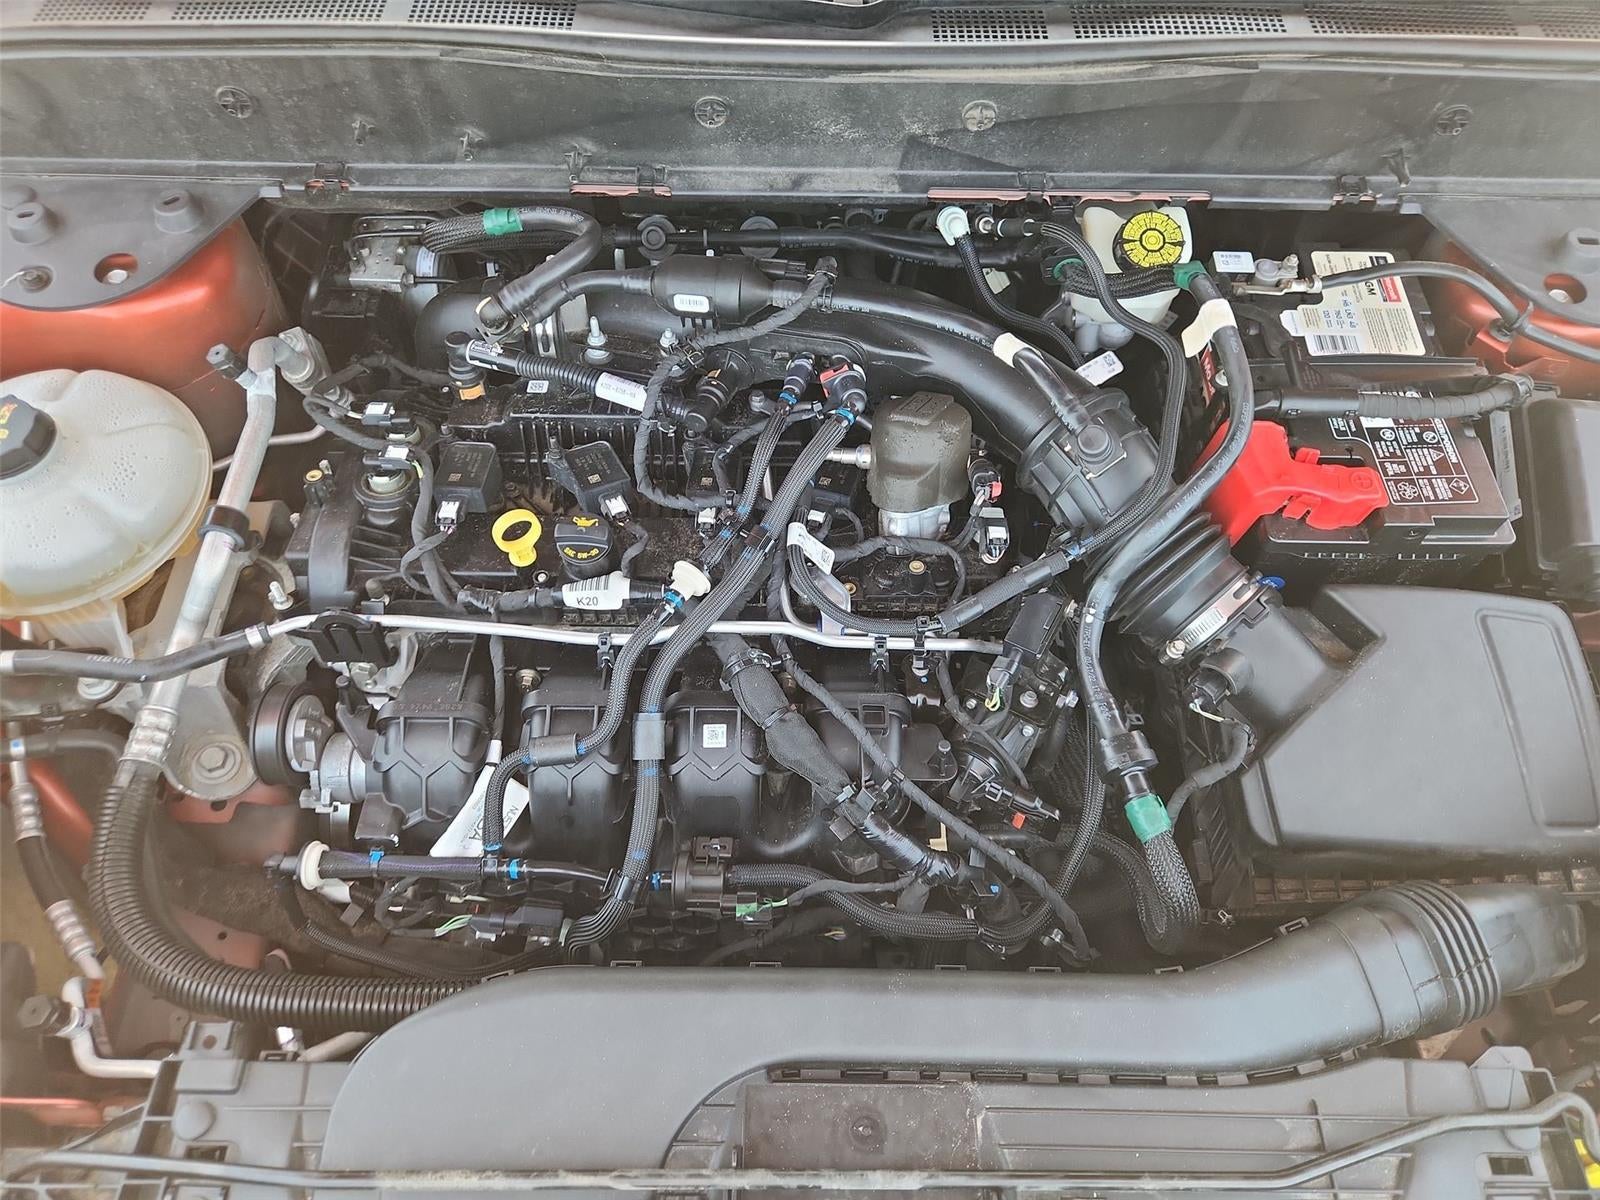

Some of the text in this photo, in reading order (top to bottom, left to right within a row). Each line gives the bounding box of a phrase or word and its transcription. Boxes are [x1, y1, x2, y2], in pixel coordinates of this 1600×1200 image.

[1364, 281, 1377, 296] GM
[1433, 418, 1458, 463] GER/POISON
[576, 596, 598, 606] K20
